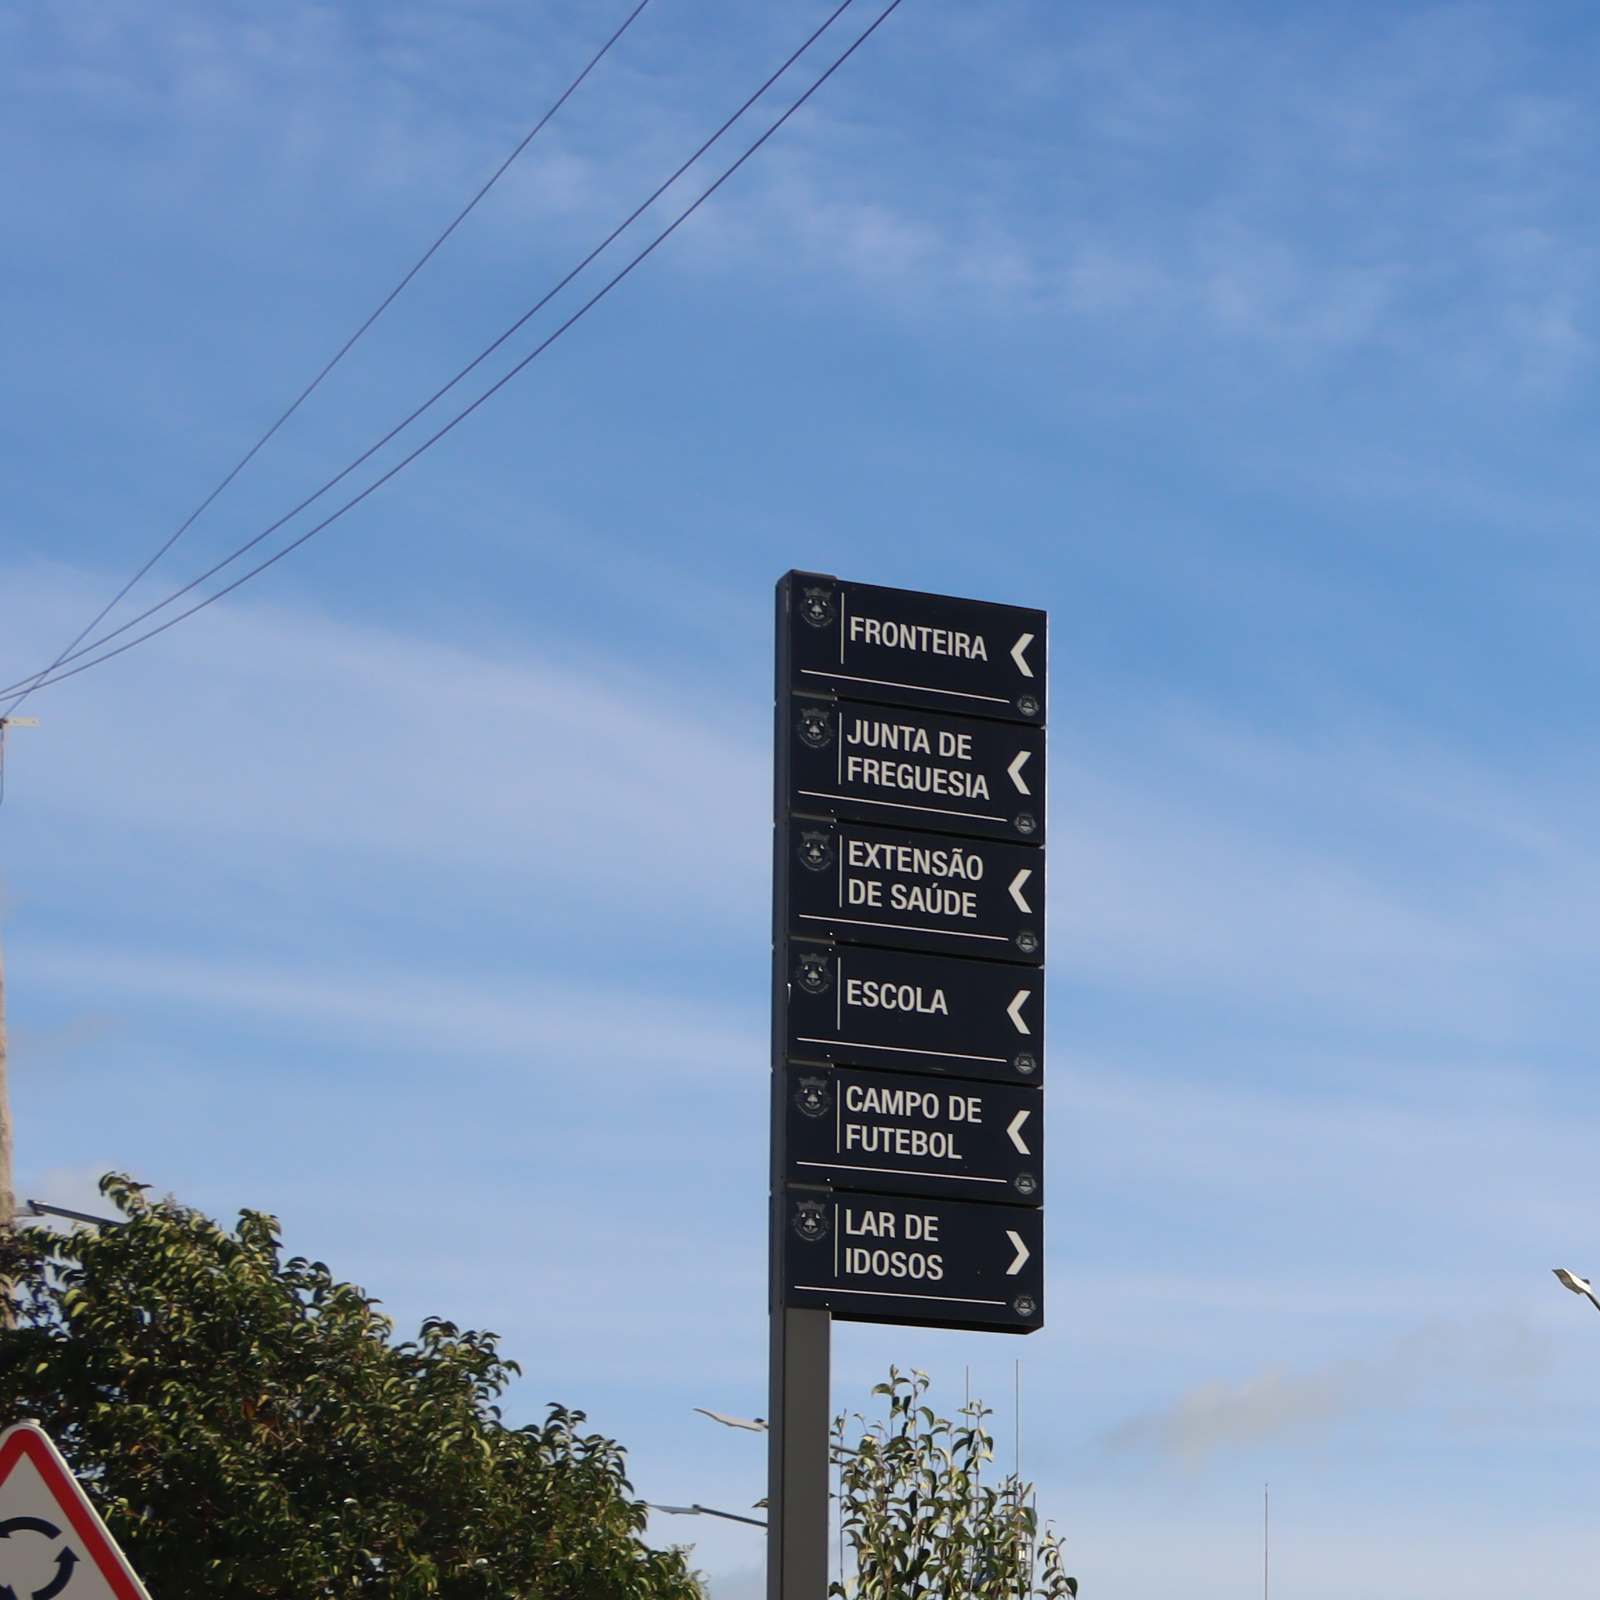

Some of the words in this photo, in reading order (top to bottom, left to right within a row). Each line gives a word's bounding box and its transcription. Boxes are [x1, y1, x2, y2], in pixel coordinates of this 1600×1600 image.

[851, 616, 987, 661] FRONTEIRA
[847, 719, 930, 755] JUNTA
[939, 732, 972, 760] DE
[848, 756, 989, 800] FREGUESIA
[849, 841, 983, 880] EXTENSÃO
[849, 879, 882, 907] DE
[890, 882, 977, 917] SAÚDE
[847, 979, 948, 1015] ESCOLA
[847, 1085, 939, 1119] CAMPO
[949, 1095, 982, 1123] DE
[846, 1124, 962, 1159] FUTEBOL
[846, 1209, 895, 1238] LAR
[905, 1214, 938, 1241] DE
[846, 1248, 943, 1280] IDOSOS
